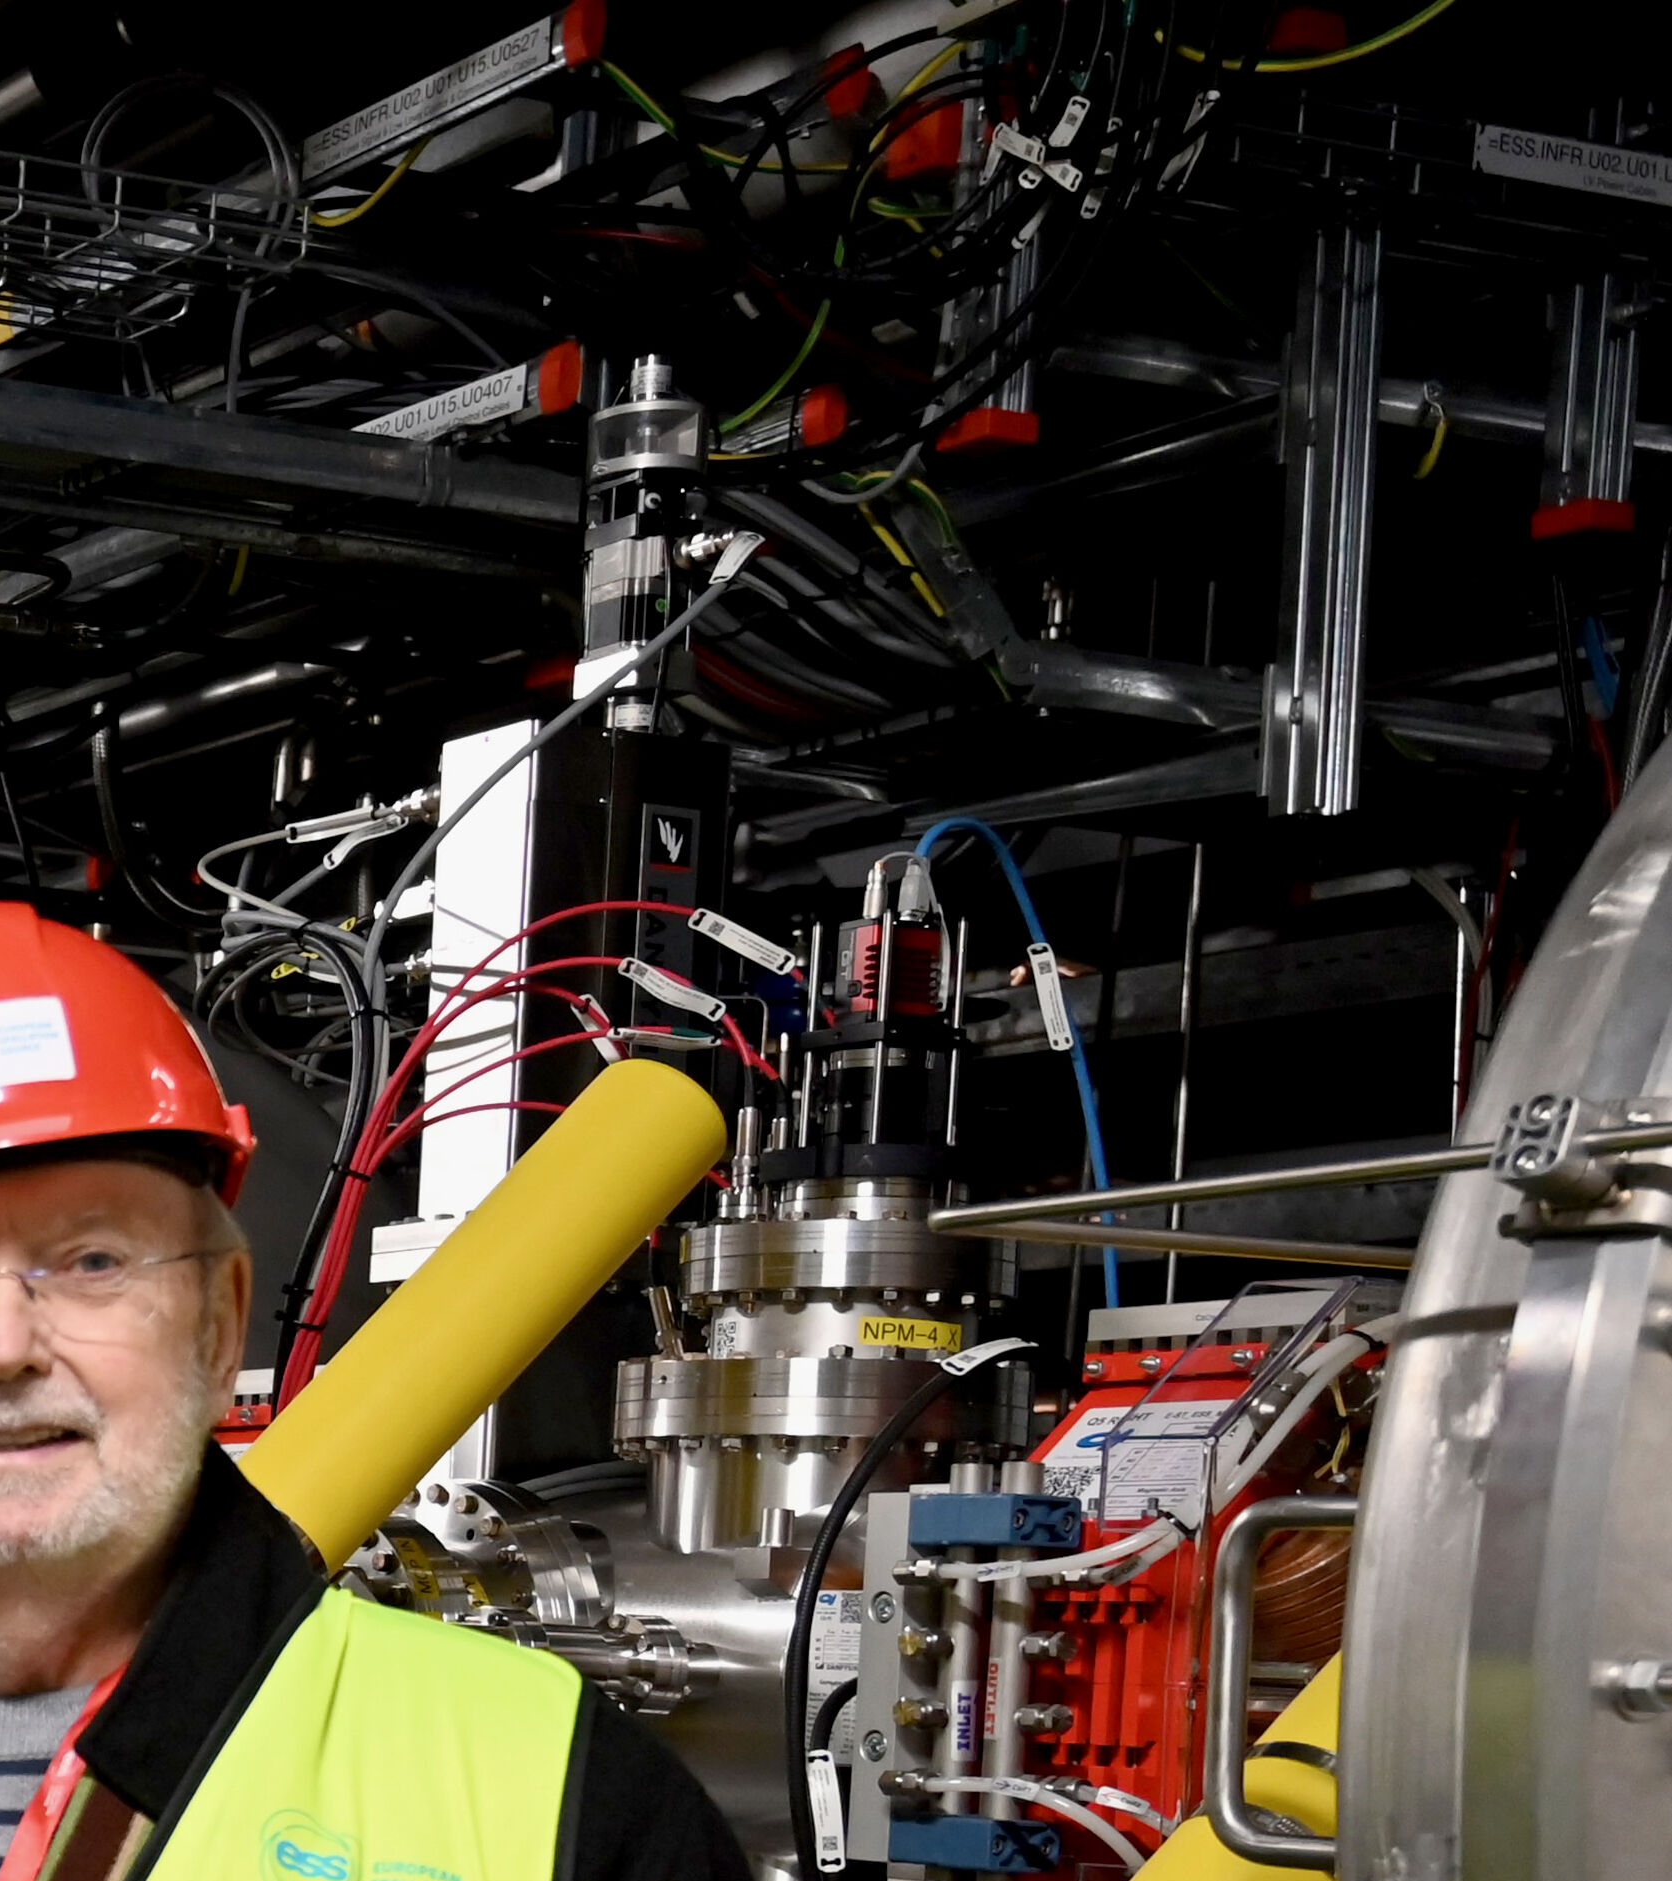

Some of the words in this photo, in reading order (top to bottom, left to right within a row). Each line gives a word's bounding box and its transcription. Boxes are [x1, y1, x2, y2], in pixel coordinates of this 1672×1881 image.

[863, 1322, 938, 1344] NPM-4
[948, 1328, 958, 1346] X
[957, 1692, 974, 1750] INLET
[985, 1663, 1000, 1735] OUTLET
[276, 1840, 348, 1881] ess
